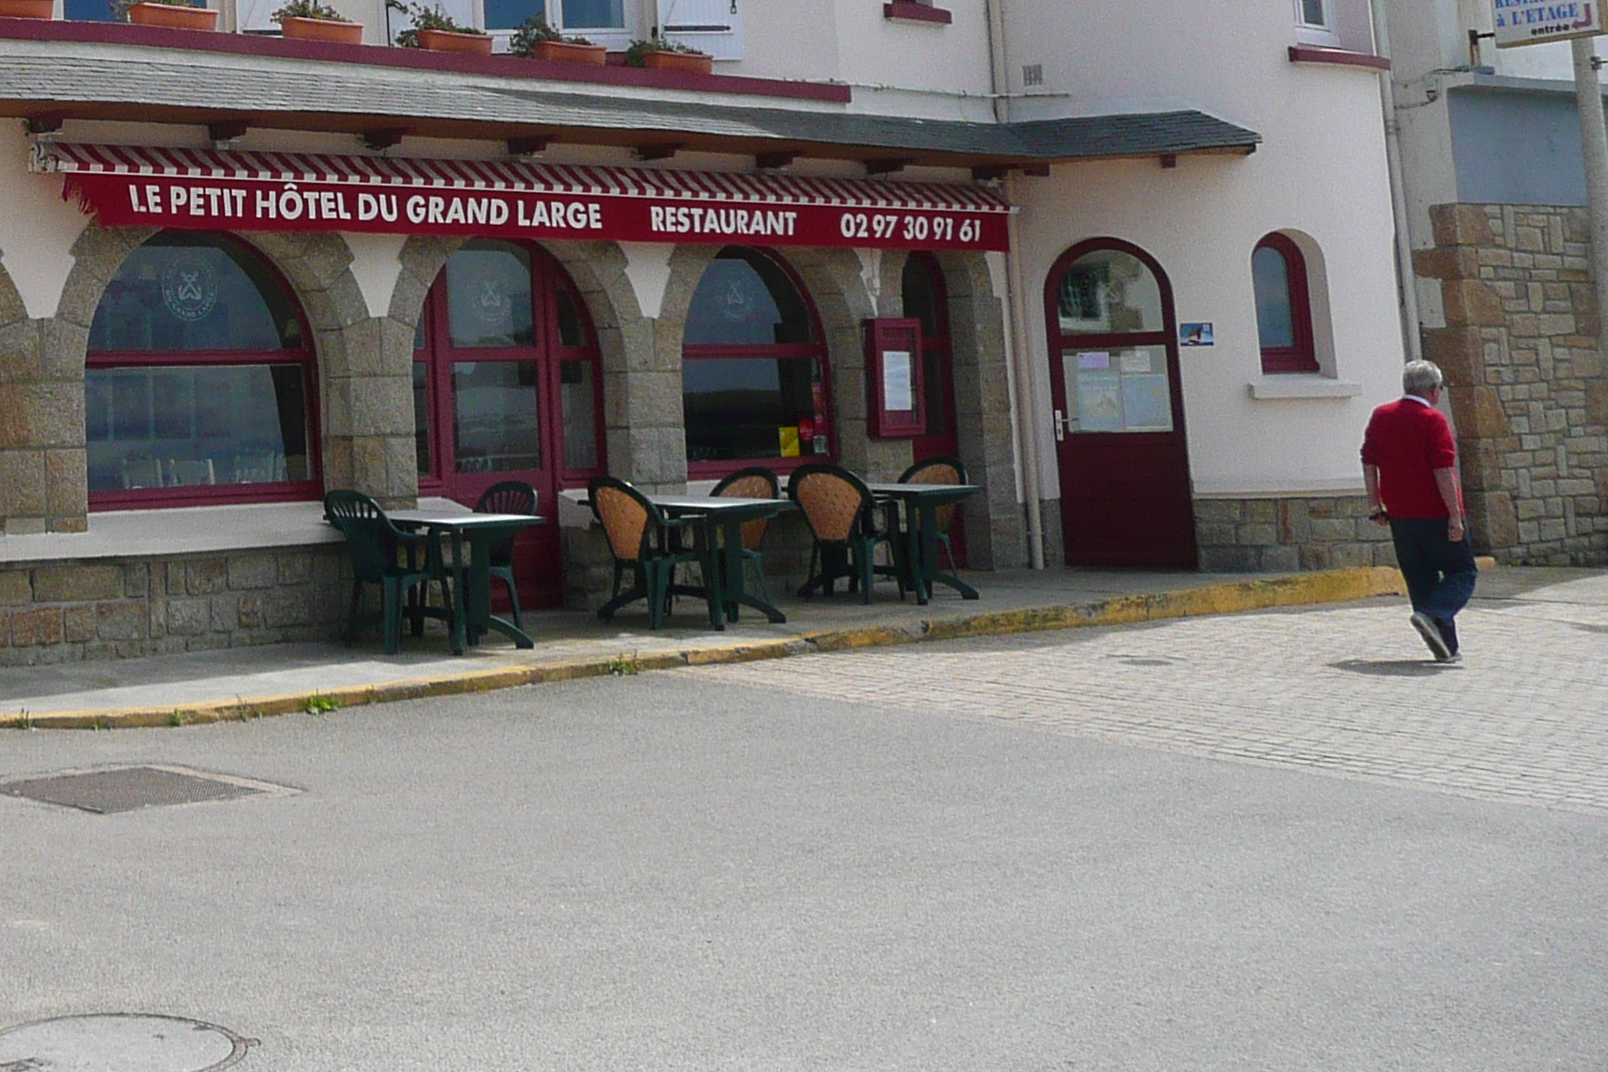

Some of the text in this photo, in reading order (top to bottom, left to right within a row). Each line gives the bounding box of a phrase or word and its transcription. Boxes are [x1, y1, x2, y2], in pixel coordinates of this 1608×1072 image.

[1531, 22, 1570, 36] entrée
[128, 183, 604, 229] LE PETIT HÔTEL DU GRAND LARGE
[649, 206, 797, 236] RESTAURANT
[840, 212, 981, 242] 02 97 30 91 61
